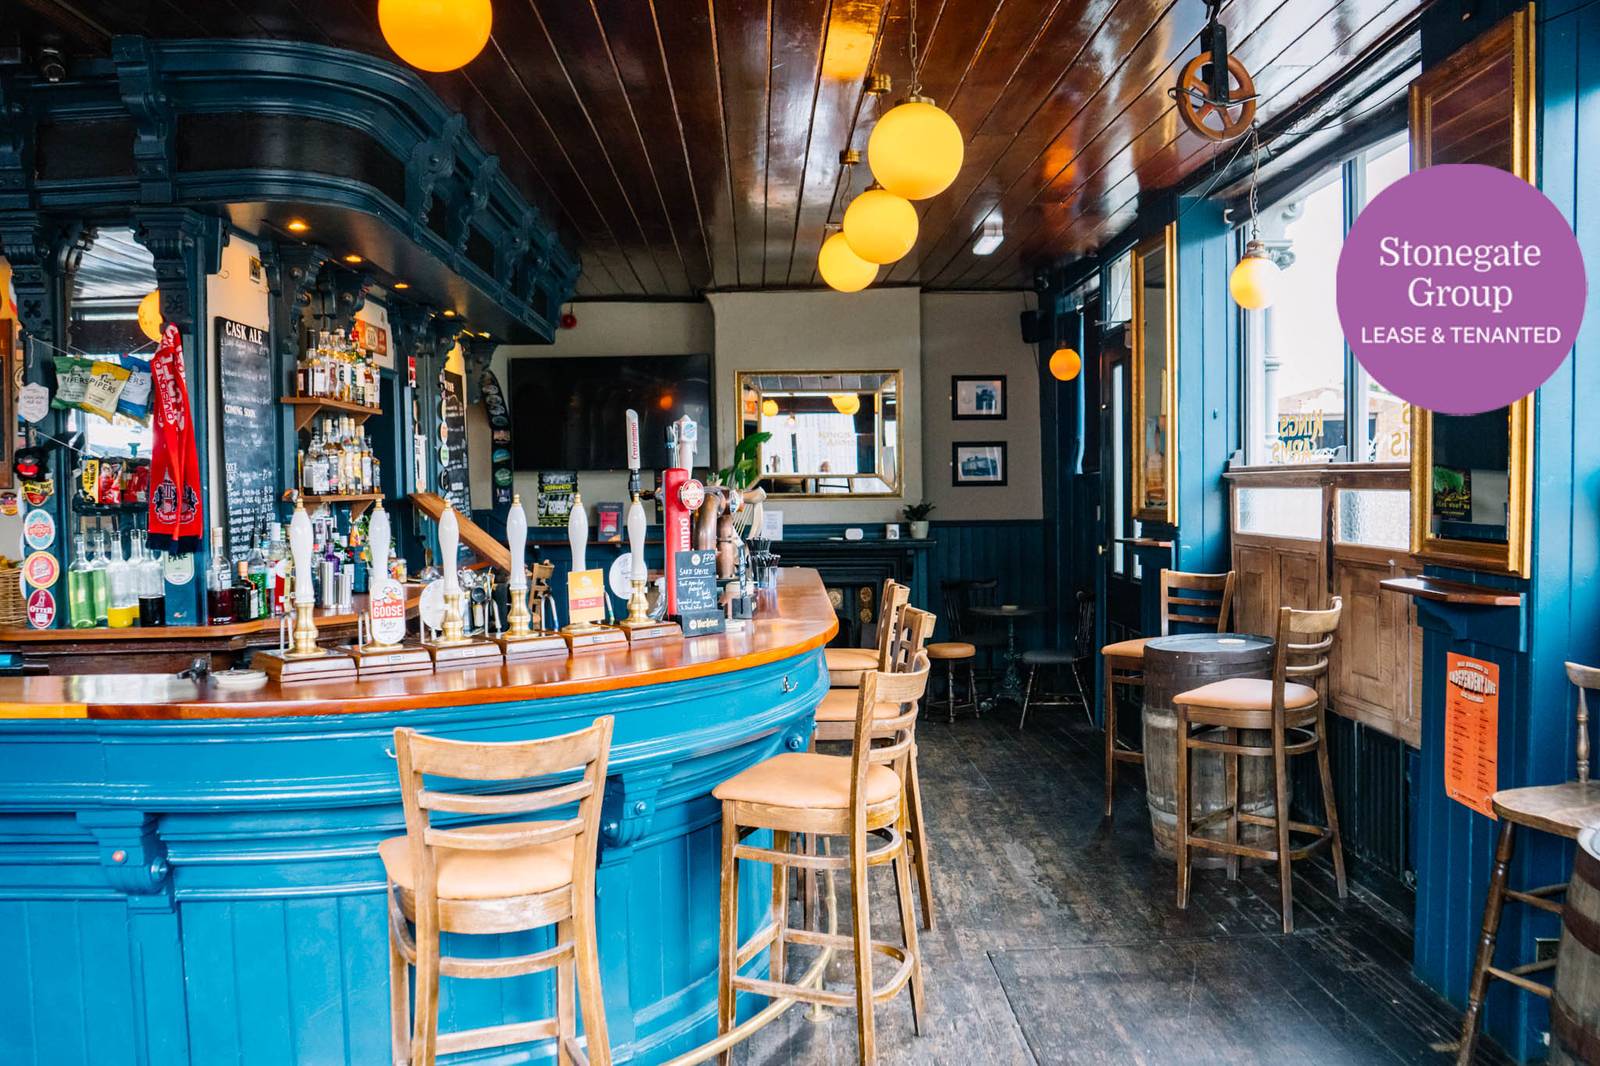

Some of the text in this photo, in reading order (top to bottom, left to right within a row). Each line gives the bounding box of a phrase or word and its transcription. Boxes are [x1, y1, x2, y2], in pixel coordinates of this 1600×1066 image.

[225, 321, 262, 345] CASK ALE
[89, 379, 116, 394] PIPERS
[30, 606, 53, 614] OTTER
[374, 604, 402, 617] GOOSE
